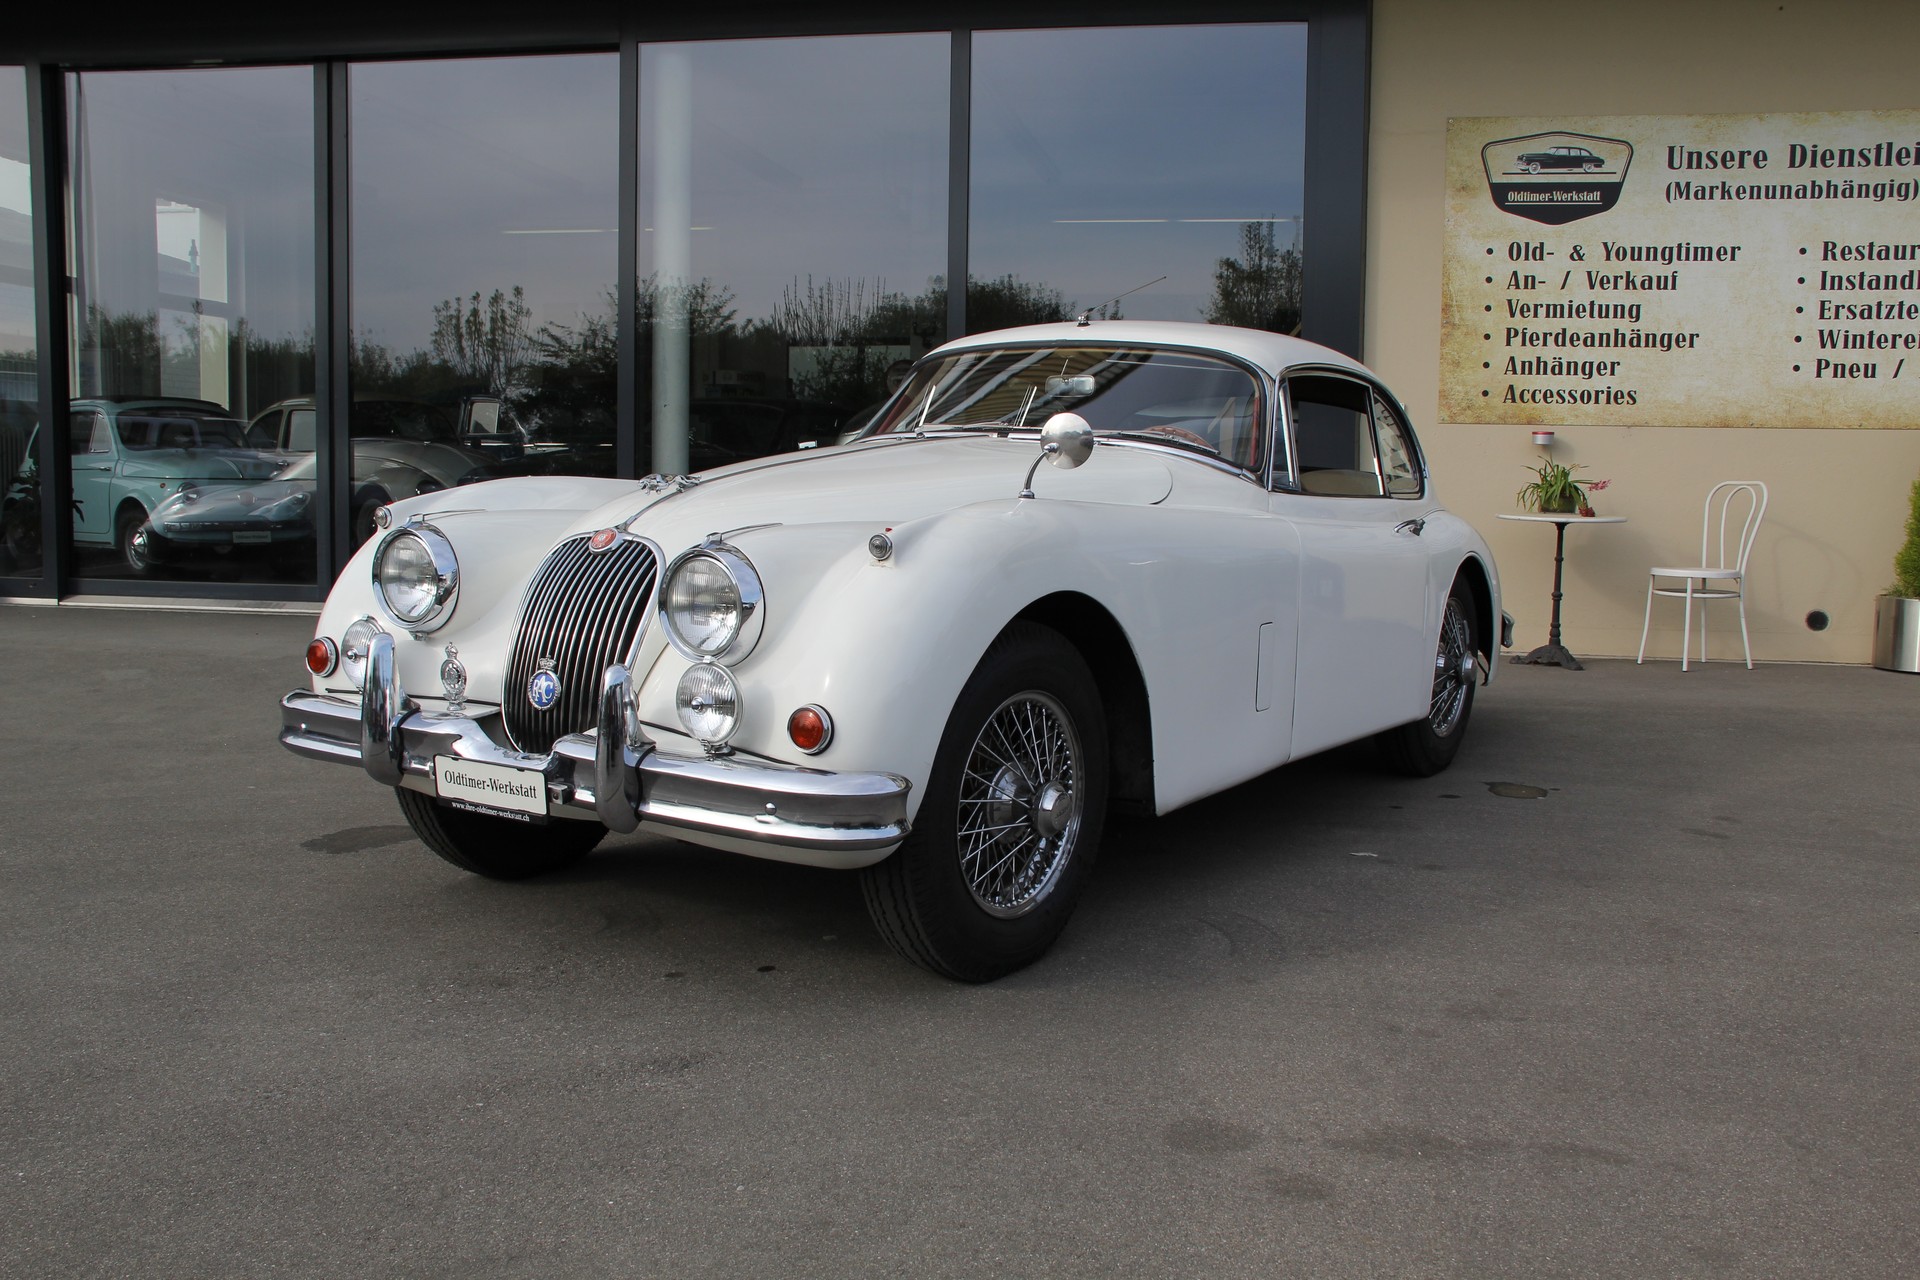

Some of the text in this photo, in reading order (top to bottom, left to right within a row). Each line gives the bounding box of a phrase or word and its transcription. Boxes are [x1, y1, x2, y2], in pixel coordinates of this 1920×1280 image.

[1666, 142, 1920, 171] Unsere Dienstlei
[1507, 191, 1601, 202] Oldtimer-Werkstatt
[1665, 179, 1919, 203] (Markenunabhängig)
[1508, 242, 1742, 265] Old- & Youngtimer
[1506, 271, 1678, 291] An- / Verkauf
[1506, 299, 1642, 323] Vermietung
[1819, 300, 1919, 320] Ersatzte
[1505, 328, 1700, 351] Pferdeanhänger
[1504, 356, 1621, 379] Anhänger
[1815, 358, 1905, 379] Pneu /
[1503, 384, 1638, 405] Accessories
[532, 675, 553, 702] RAC
[444, 770, 537, 799] Oldtimer-Werkstatt
